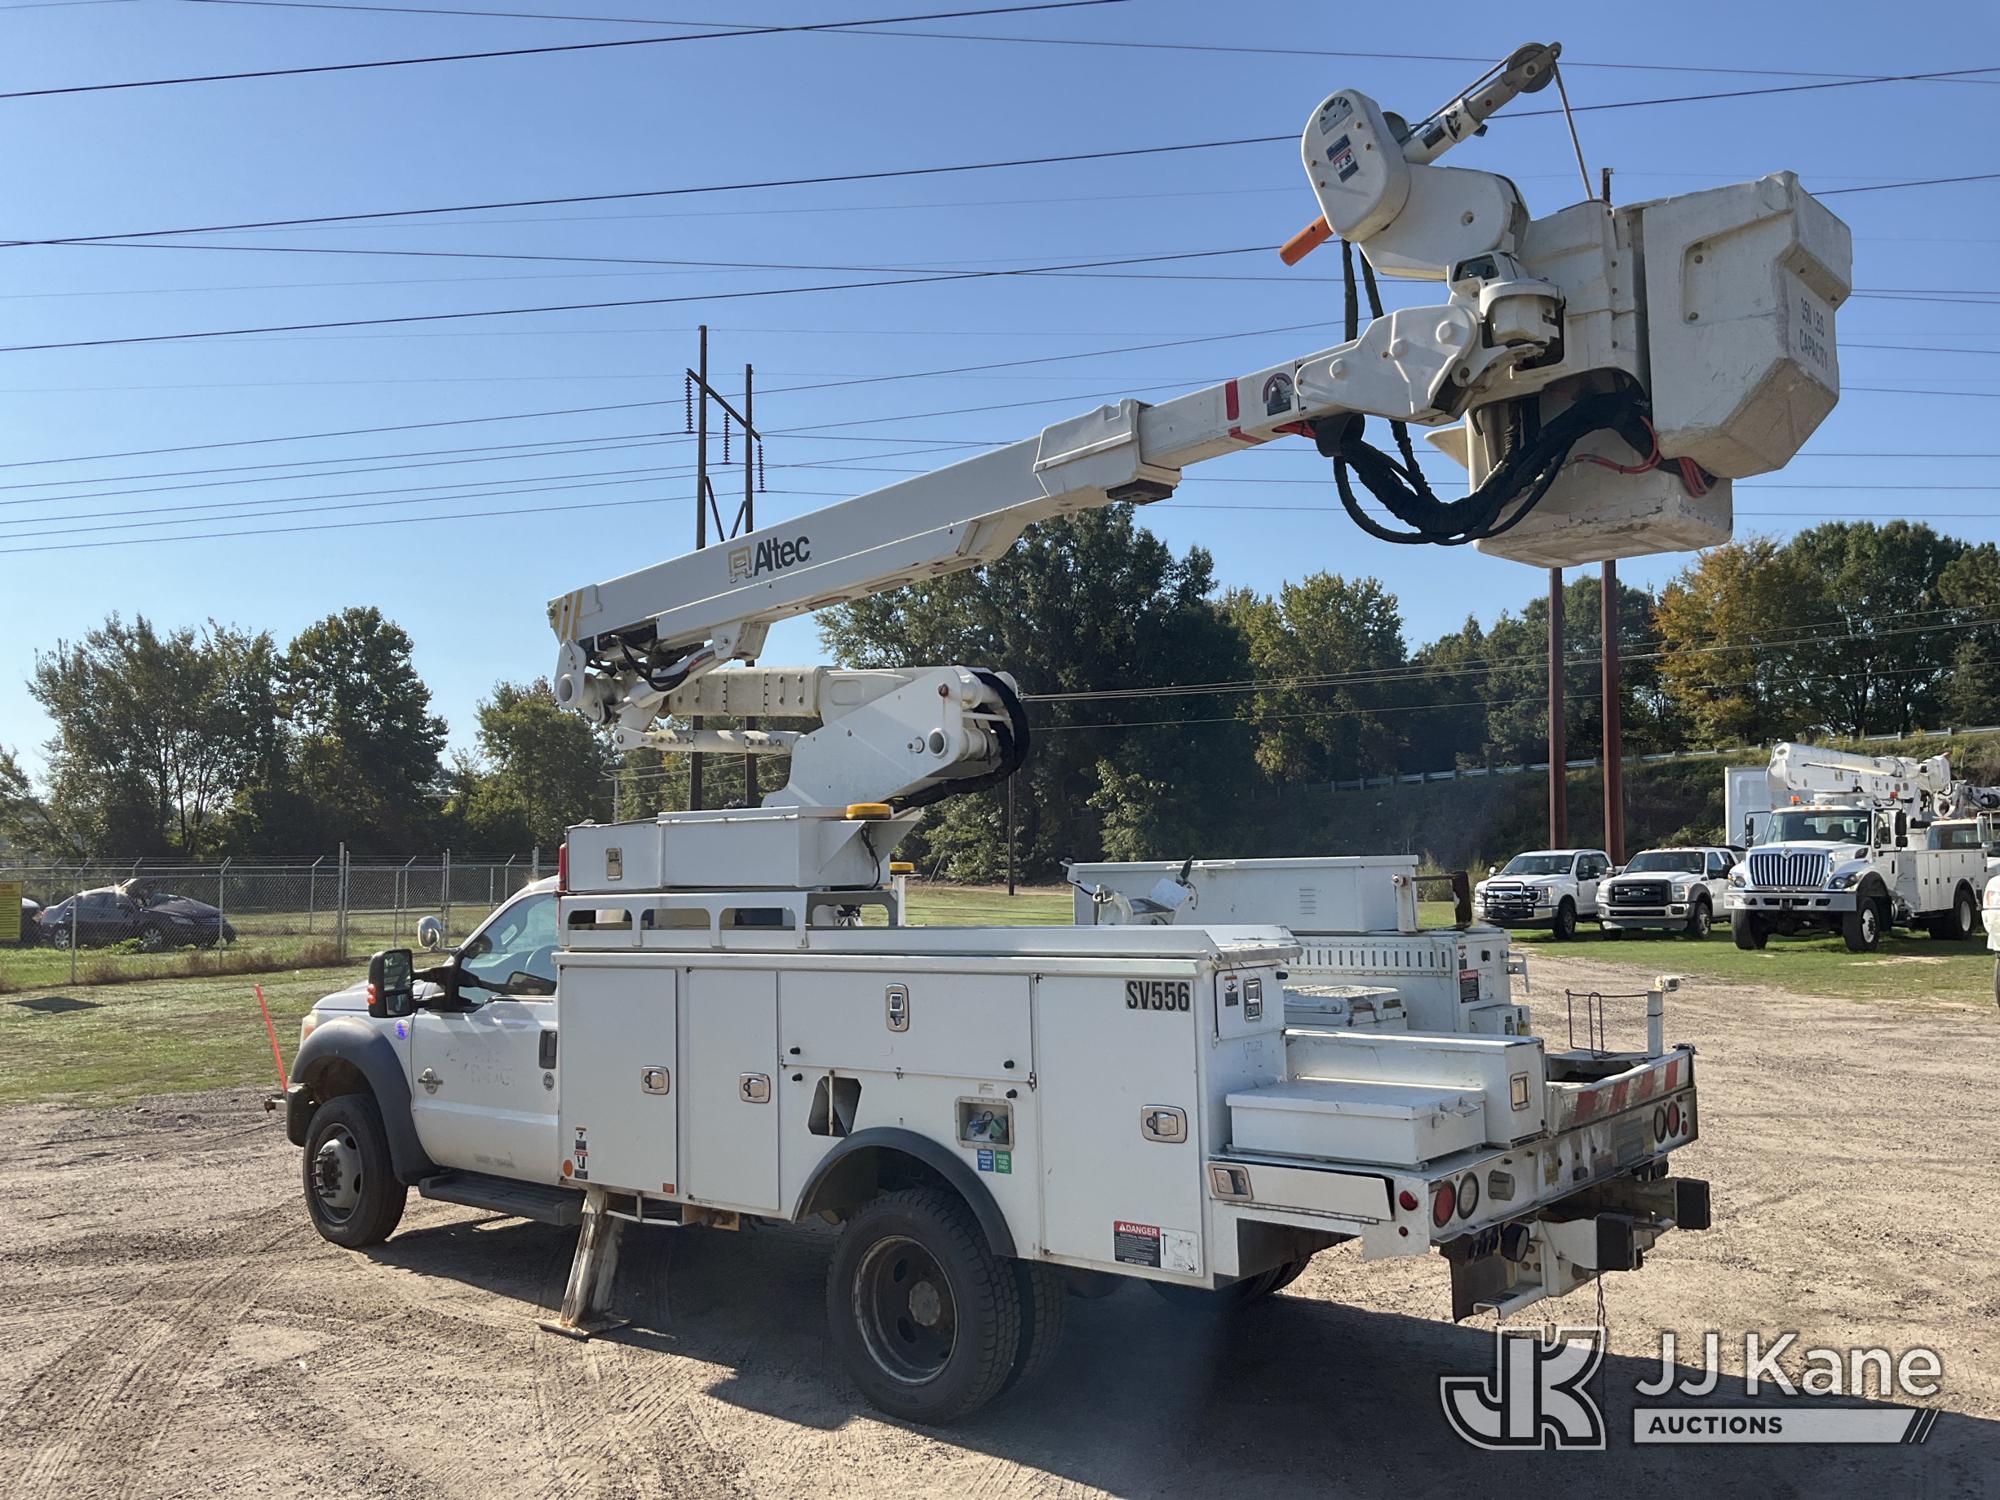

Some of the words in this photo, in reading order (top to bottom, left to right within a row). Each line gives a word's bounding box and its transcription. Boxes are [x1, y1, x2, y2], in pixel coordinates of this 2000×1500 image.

[753, 536, 811, 576] Altec
[1126, 980, 1190, 1012] SV556
[1125, 1224, 1158, 1236] DANGER
